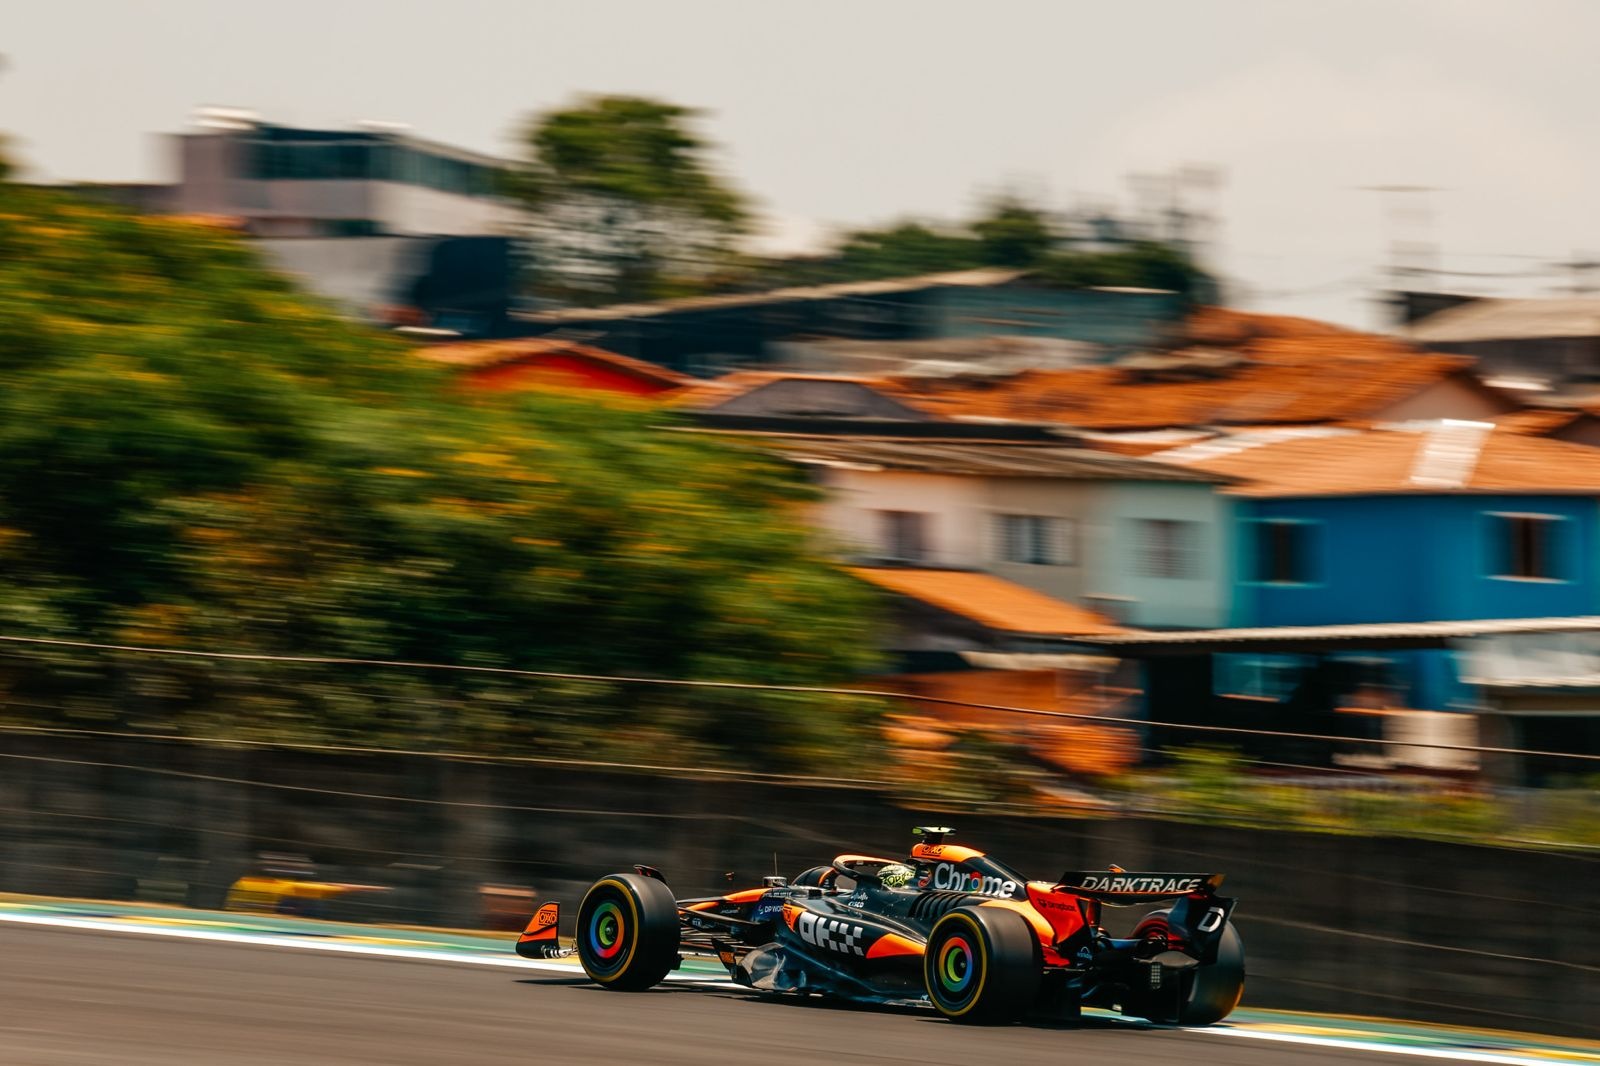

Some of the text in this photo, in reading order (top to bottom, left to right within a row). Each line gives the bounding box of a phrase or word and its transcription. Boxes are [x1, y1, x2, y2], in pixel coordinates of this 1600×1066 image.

[934, 862, 1015, 898] Chrome
[1080, 877, 1202, 893] DARKTRACE
[798, 911, 865, 957] OKX
[1197, 907, 1225, 933] D
